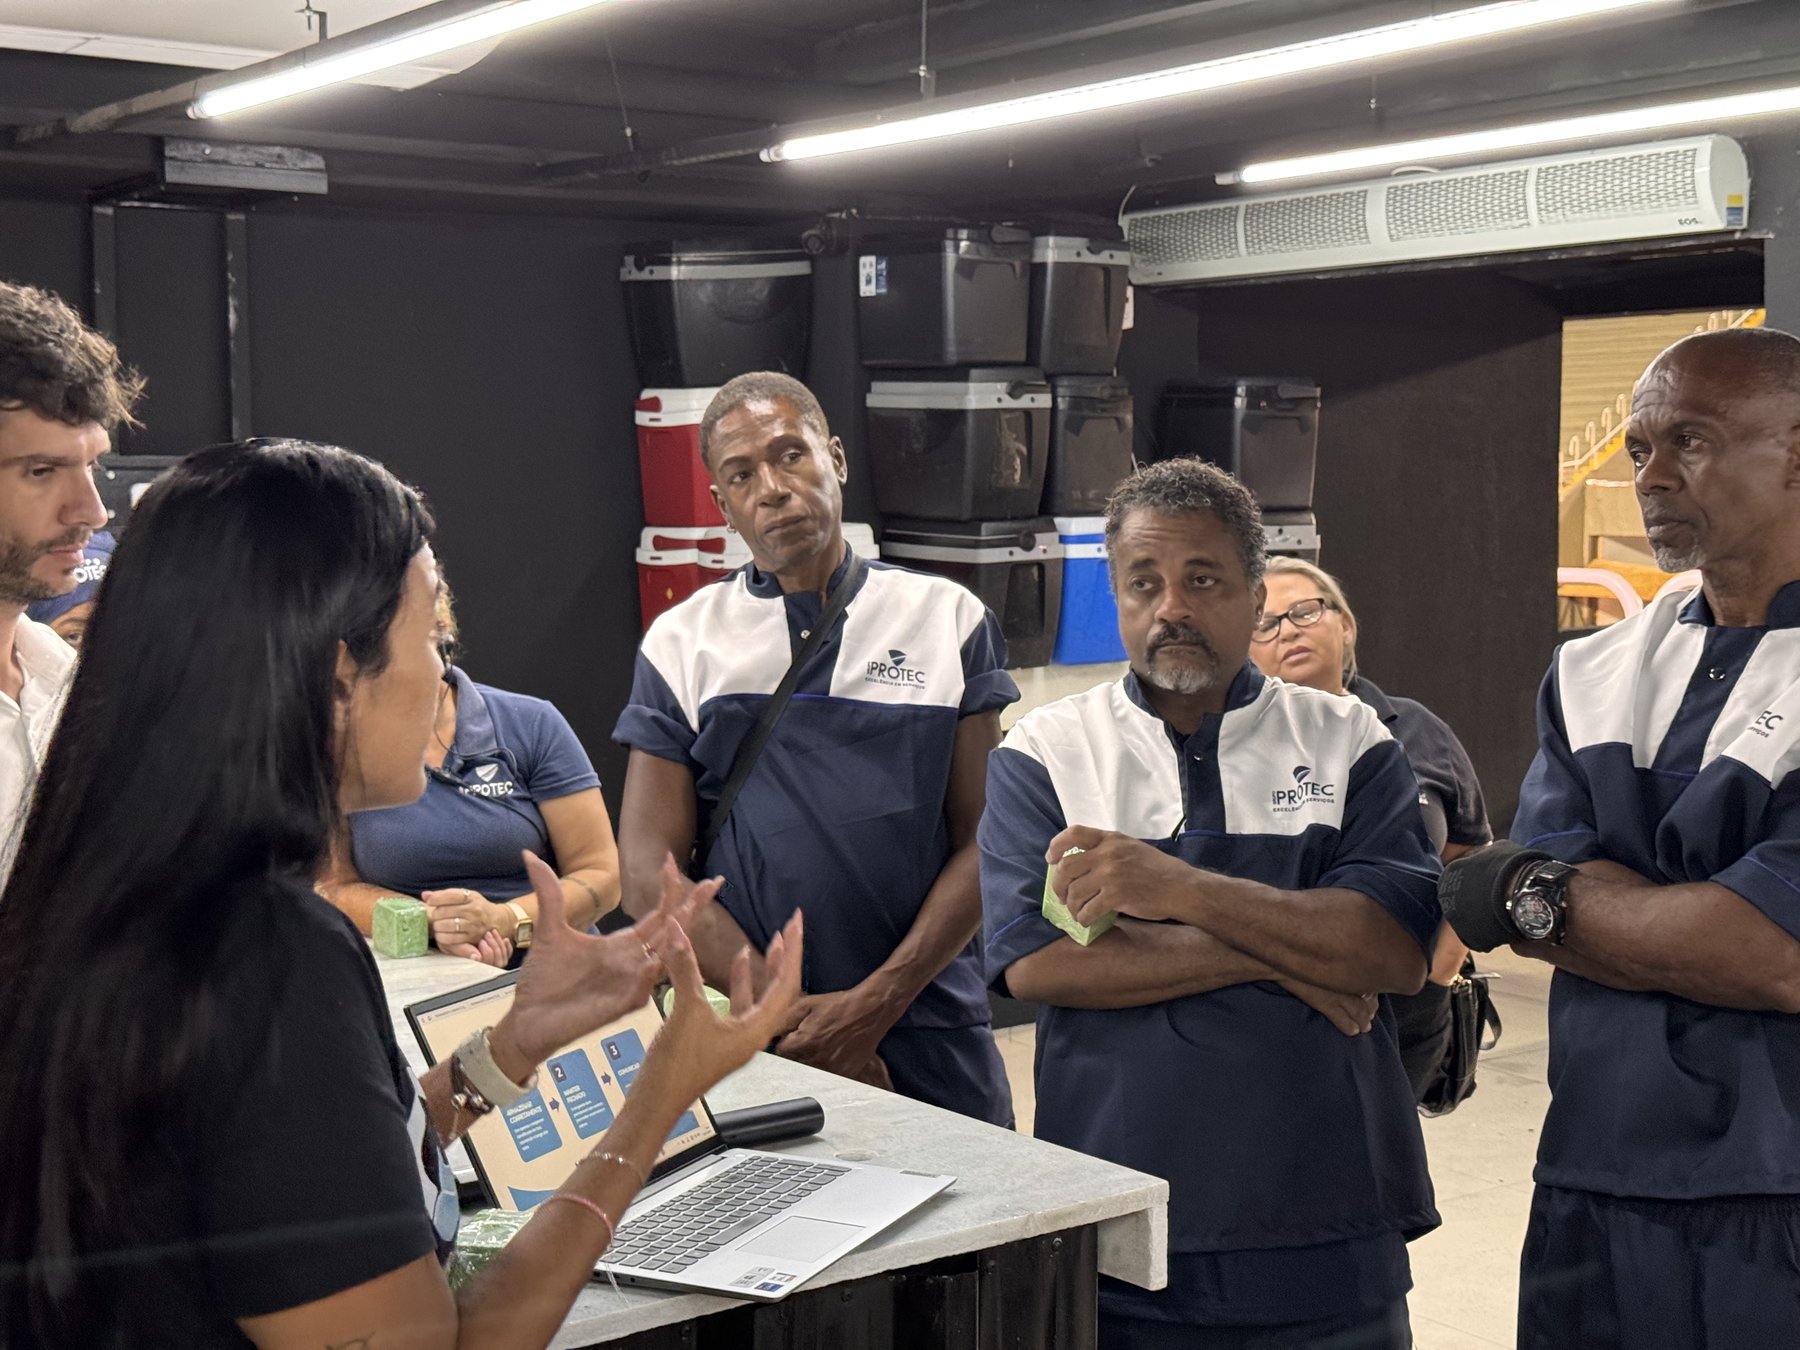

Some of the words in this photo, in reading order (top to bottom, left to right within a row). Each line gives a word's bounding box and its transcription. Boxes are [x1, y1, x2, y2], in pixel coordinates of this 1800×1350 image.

[867, 661, 925, 683] IPROTEC
[1755, 710, 1784, 730] EC
[609, 1045, 618, 1056] 3
[554, 1067, 564, 1078] 2
